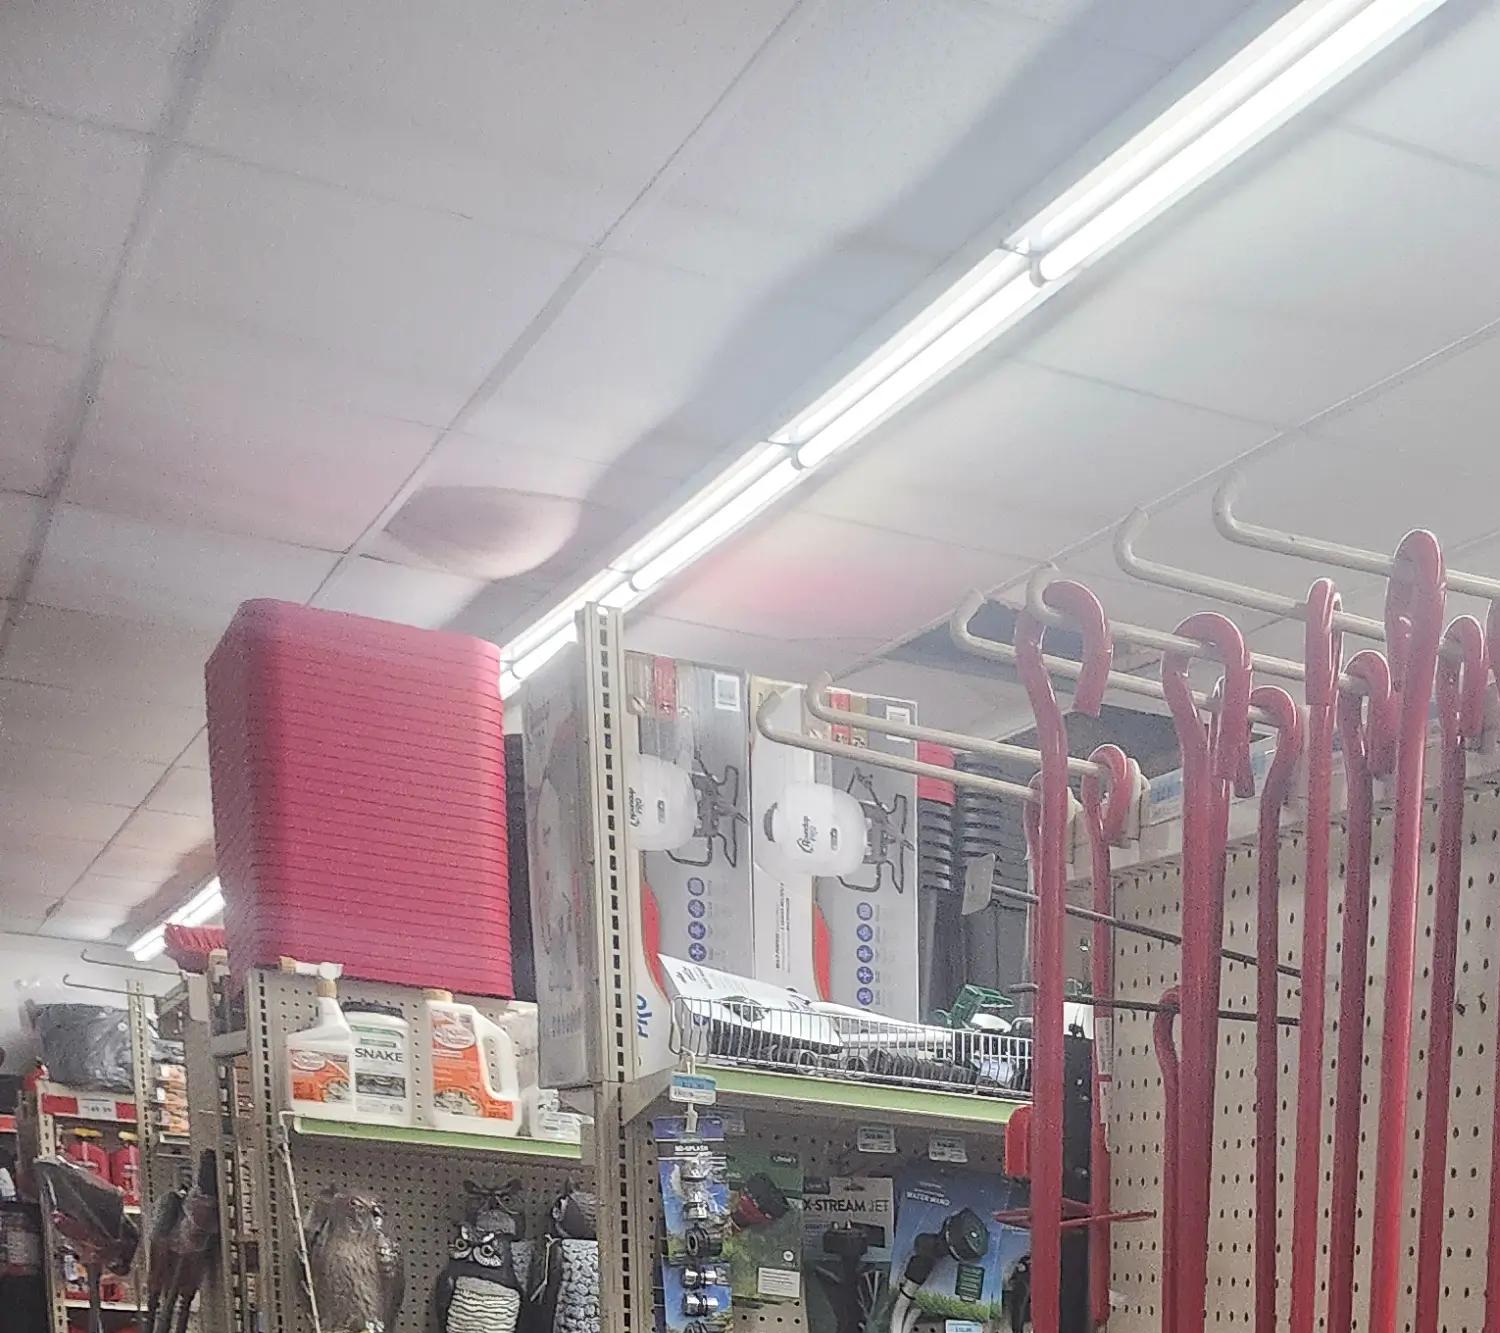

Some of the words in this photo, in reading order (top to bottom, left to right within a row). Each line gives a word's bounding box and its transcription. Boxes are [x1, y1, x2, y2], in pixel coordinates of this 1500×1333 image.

[354, 1047, 404, 1063] SNAKE
[803, 1199, 866, 1212] X-STREAM
[868, 1199, 889, 1212] JET
